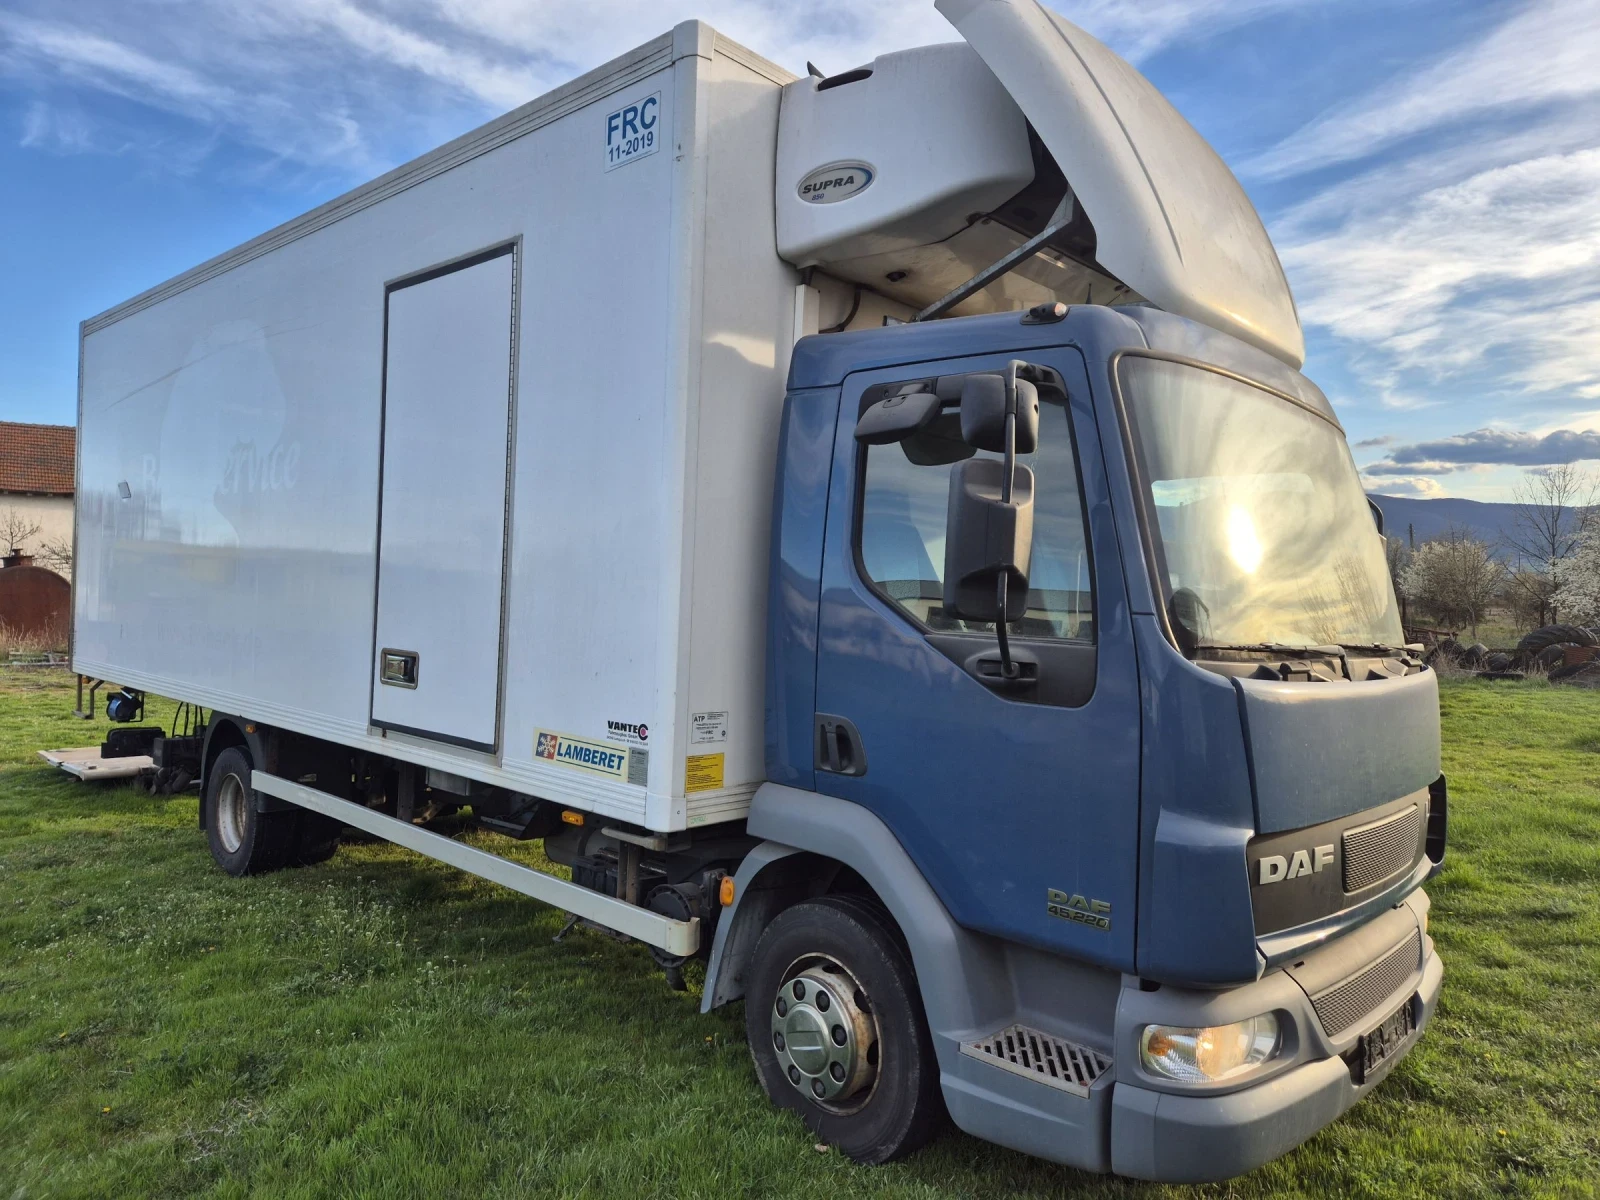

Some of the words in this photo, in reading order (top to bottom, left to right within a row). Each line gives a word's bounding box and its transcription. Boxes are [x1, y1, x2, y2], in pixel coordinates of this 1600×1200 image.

[607, 97, 657, 146] FRC
[608, 131, 654, 163] 11-2019
[802, 175, 855, 194] SUPRA
[811, 192, 825, 201] 850
[607, 720, 649, 741] VANTEC
[557, 742, 625, 770] LAMBERET
[1260, 844, 1335, 885] DAF
[1048, 888, 1112, 913] DAF
[1048, 905, 1110, 929] 45.220
